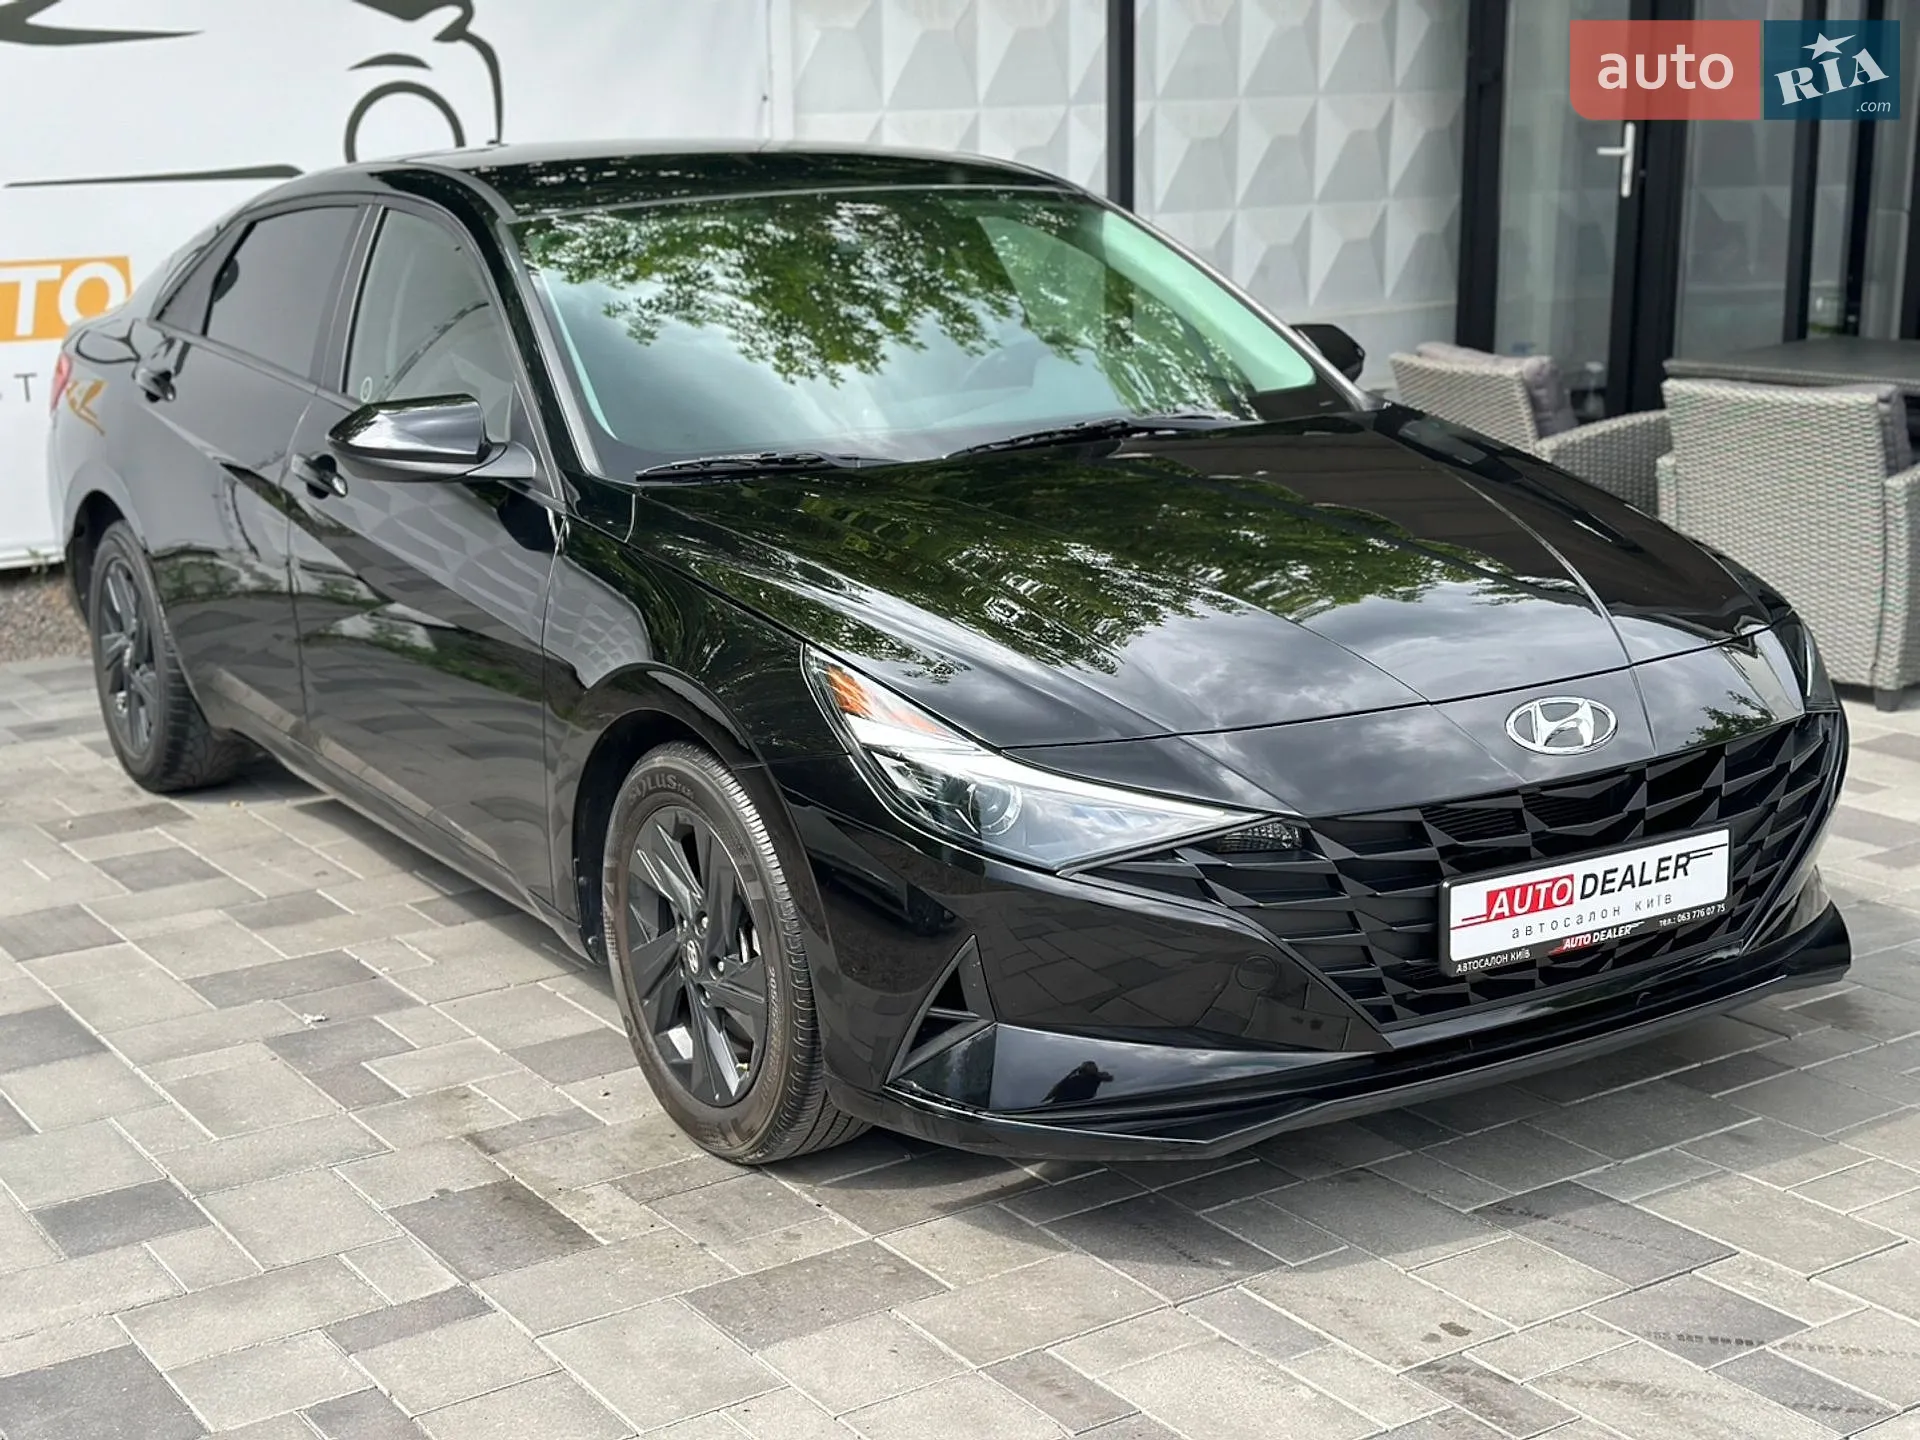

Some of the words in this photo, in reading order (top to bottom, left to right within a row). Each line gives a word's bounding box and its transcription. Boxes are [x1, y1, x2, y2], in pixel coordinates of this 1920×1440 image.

[1488, 877, 1573, 920] AUTO
[1580, 853, 1691, 900] DEALER
[1512, 906, 1621, 939] автосалон
[1563, 933, 1592, 950] AUTO
[1592, 924, 1632, 943] DEALER
[1456, 954, 1508, 974] АВТОСАЛОН
